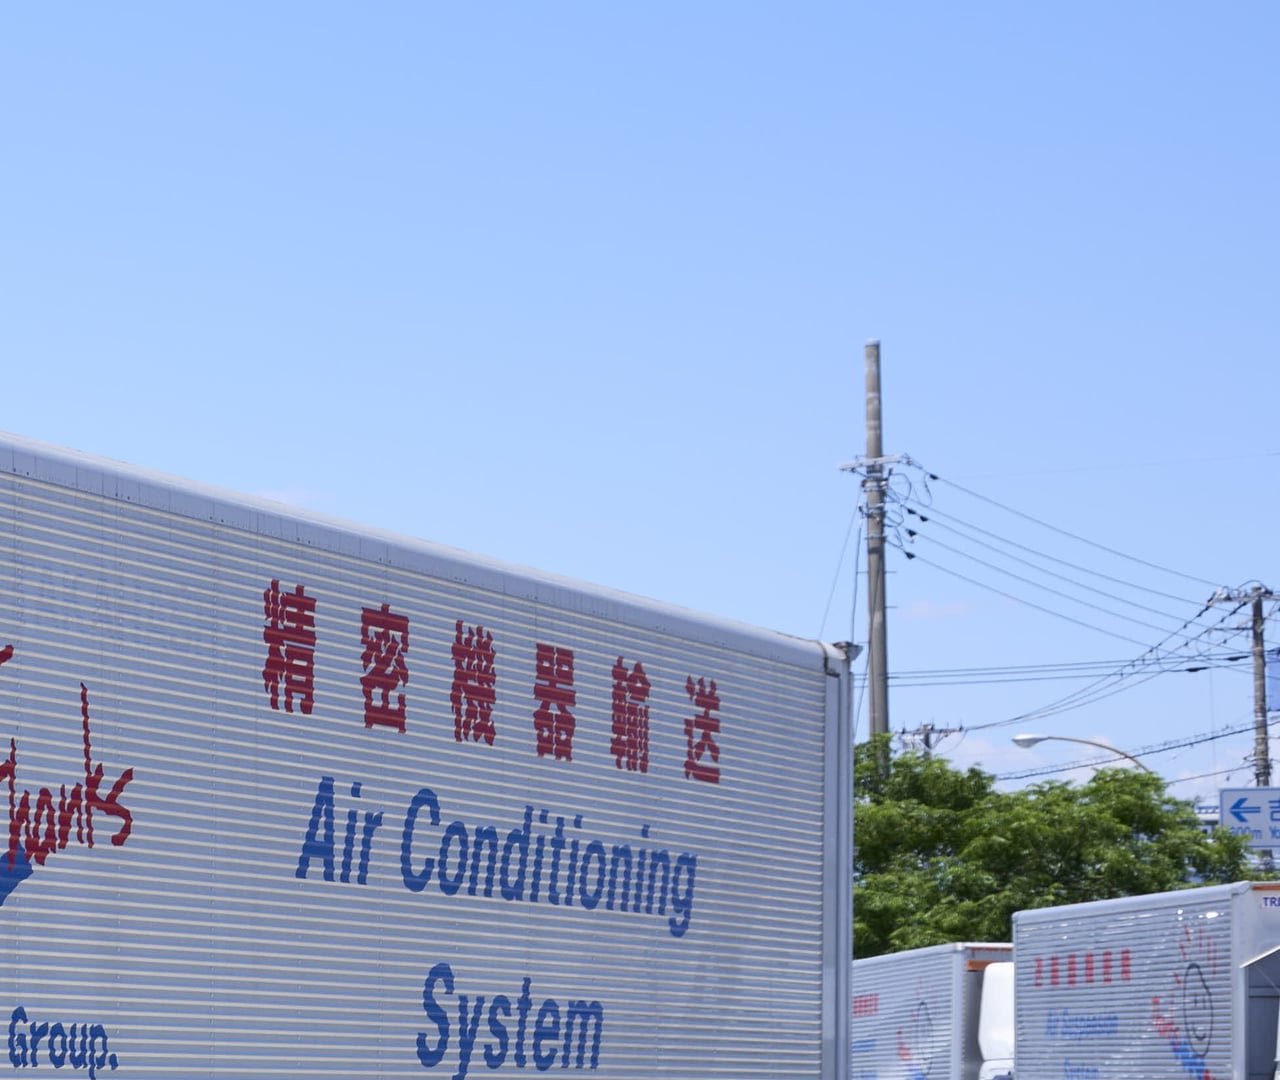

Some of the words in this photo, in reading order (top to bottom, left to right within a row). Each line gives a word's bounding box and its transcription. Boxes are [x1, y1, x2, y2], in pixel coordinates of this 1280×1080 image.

[262, 578, 722, 784] 精密機器輸送
[295, 776, 385, 886] Air
[400, 788, 698, 938] Conditioning
[8, 1005, 119, 1080] Group.
